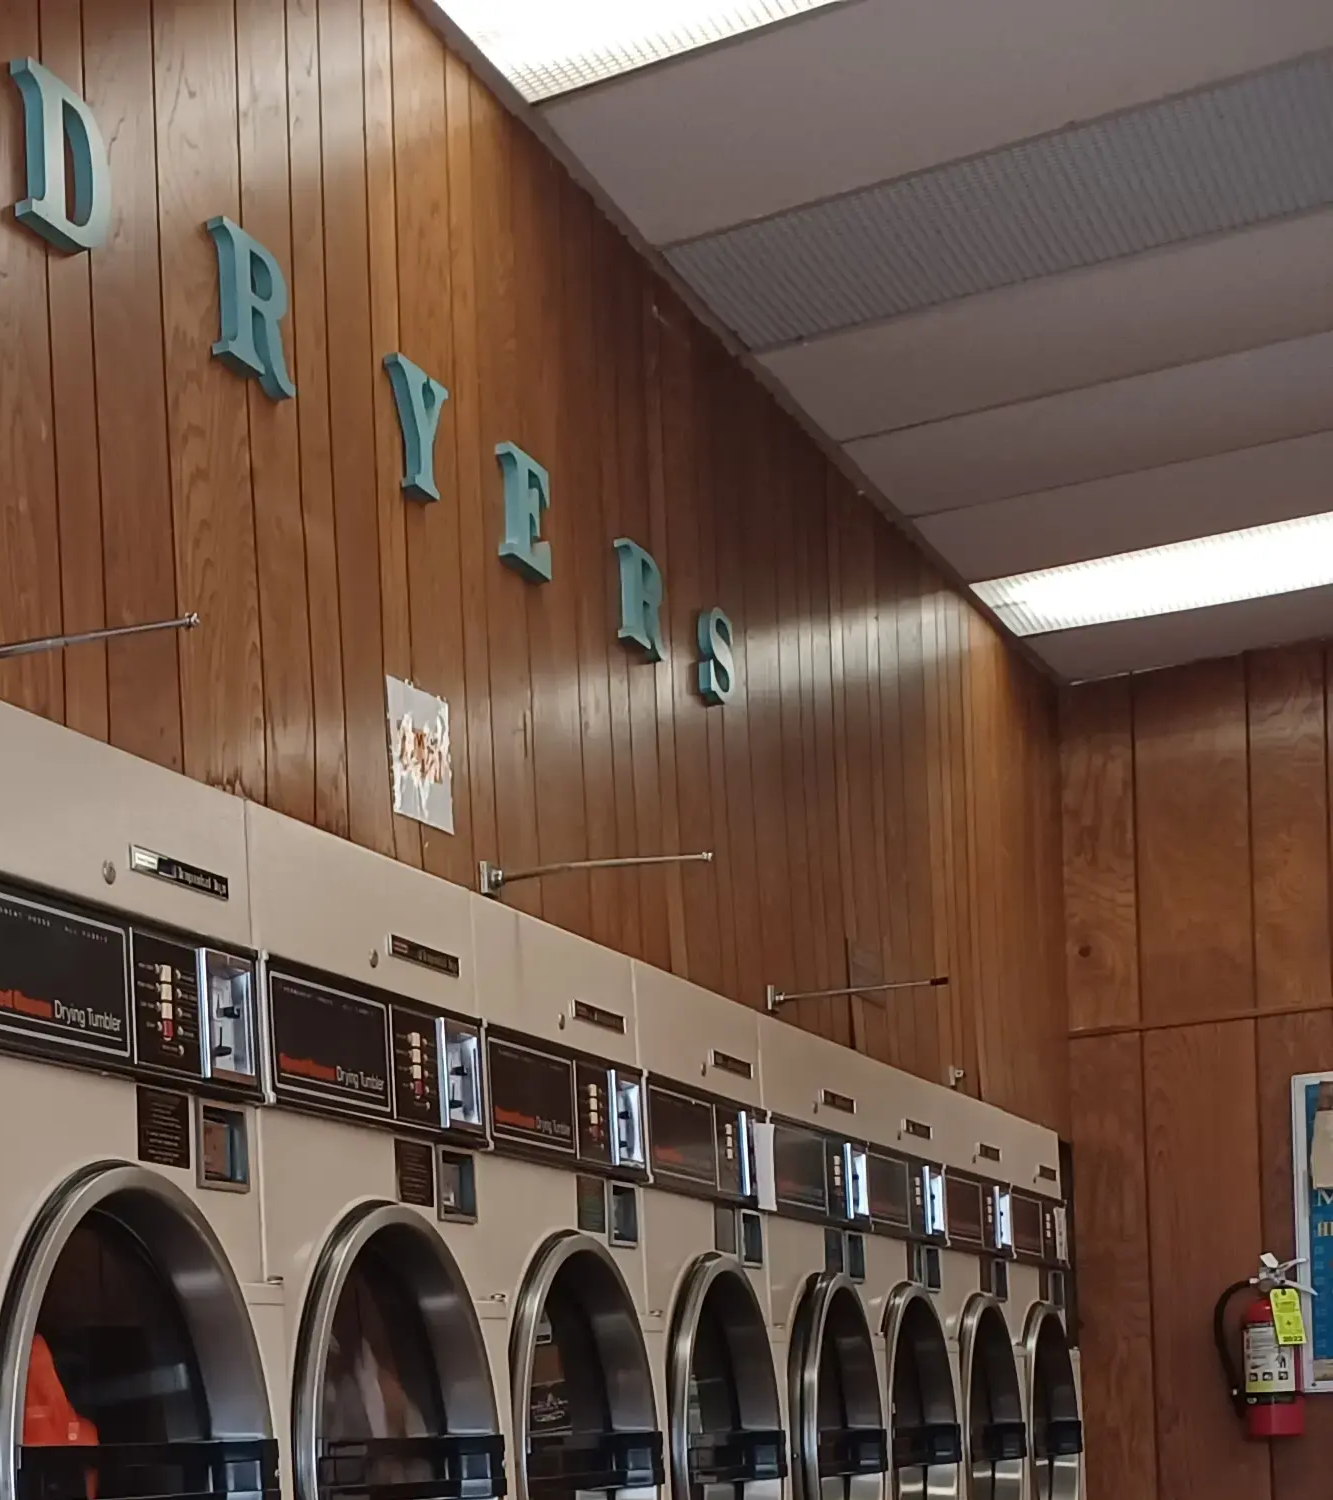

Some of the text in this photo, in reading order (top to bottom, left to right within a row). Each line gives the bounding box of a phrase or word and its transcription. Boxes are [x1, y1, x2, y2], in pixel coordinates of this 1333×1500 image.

[8, 56, 735, 706] DRYERS
[54, 999, 86, 1028] Drying
[86, 1007, 122, 1031] Tumbler
